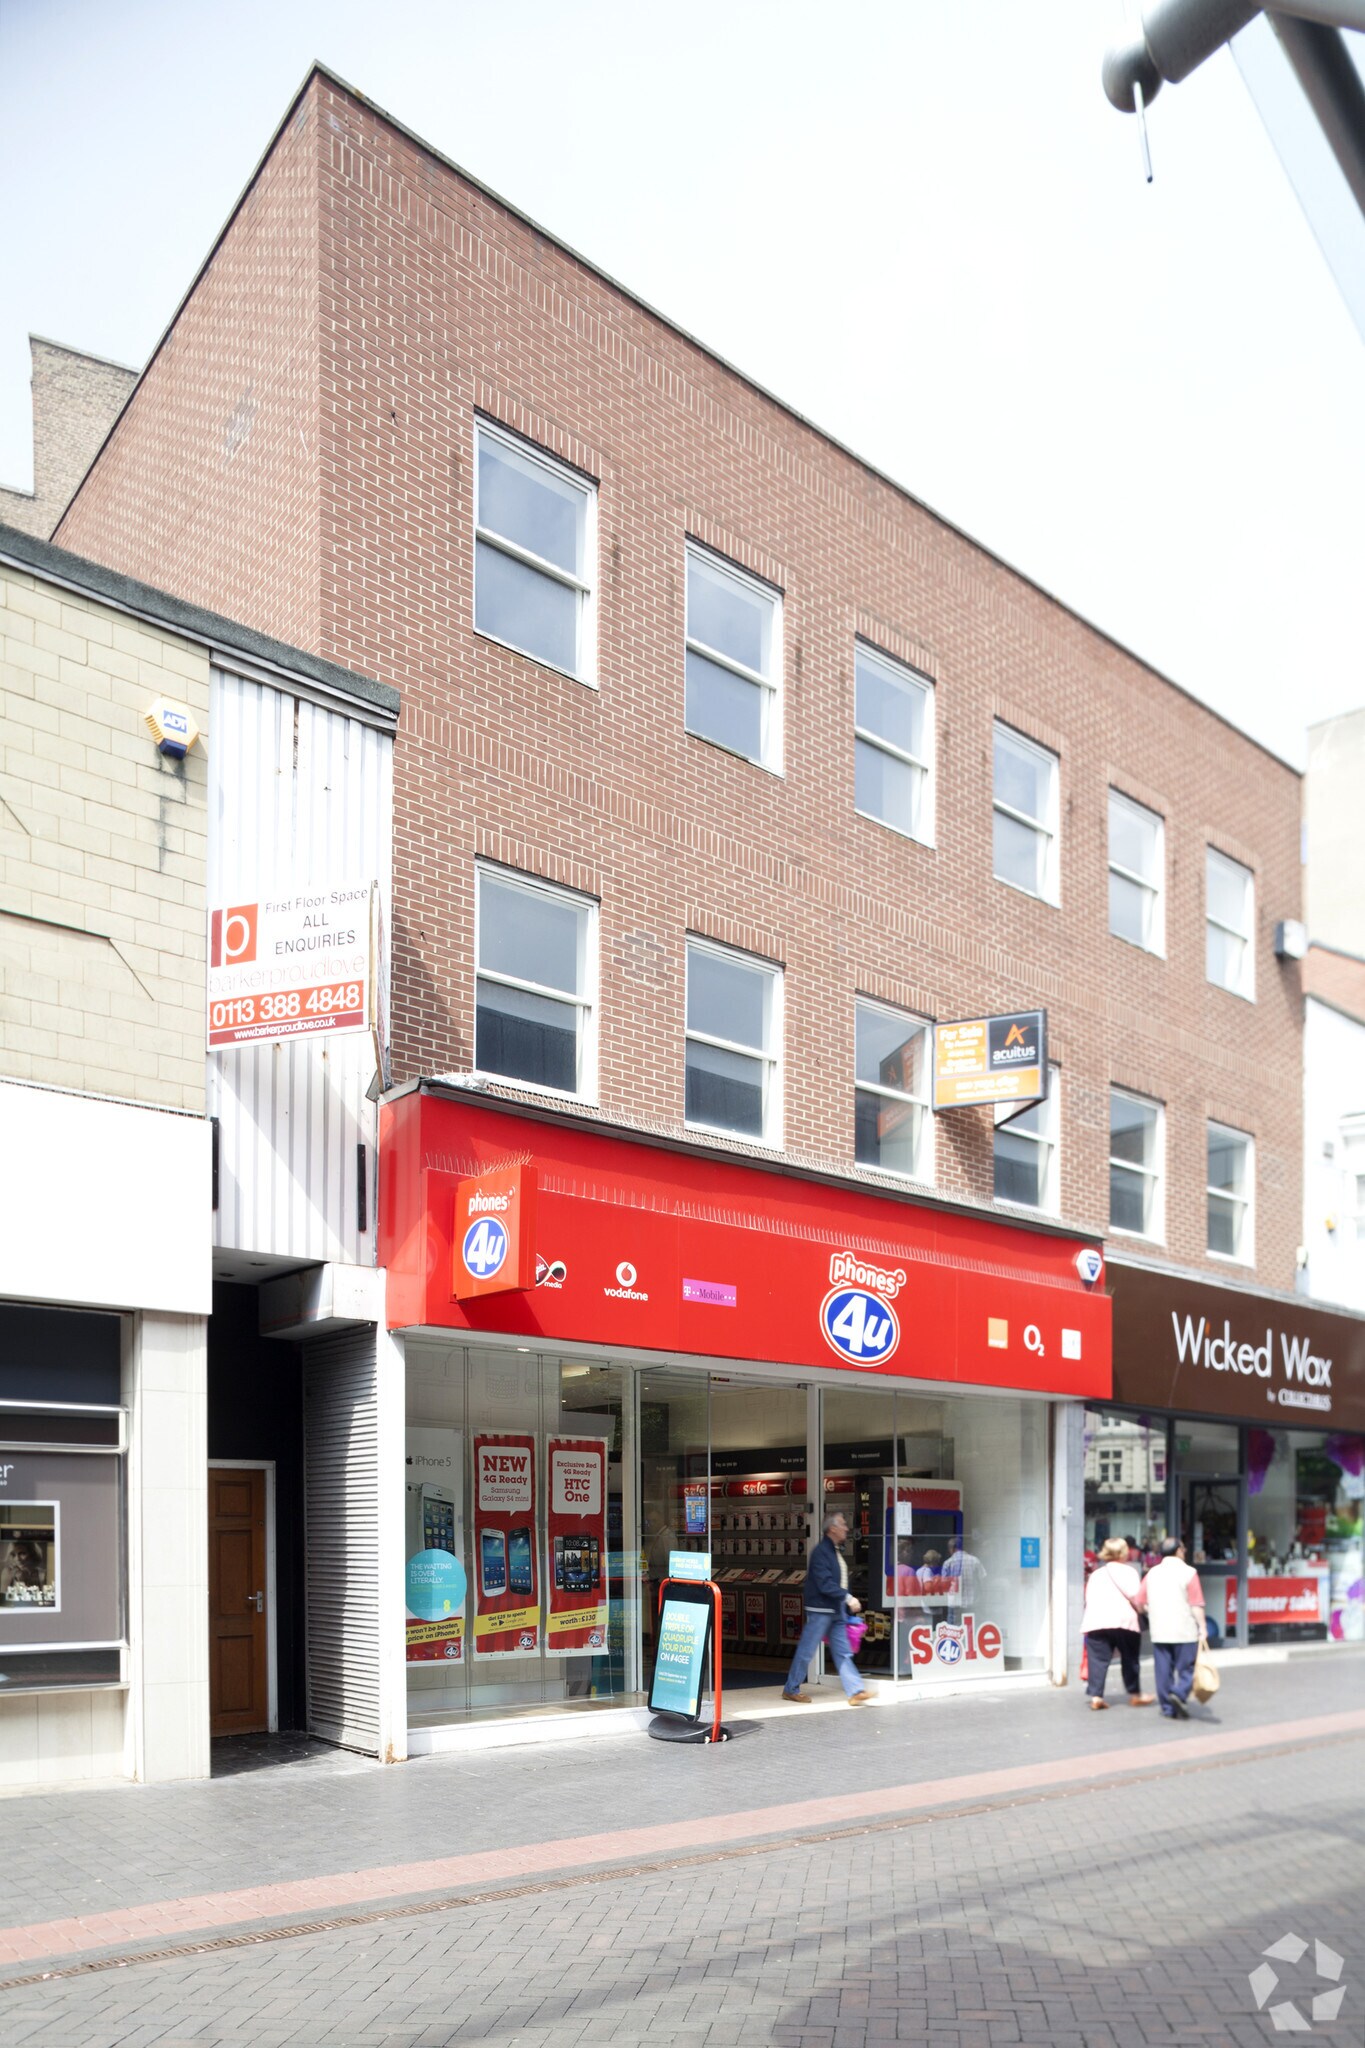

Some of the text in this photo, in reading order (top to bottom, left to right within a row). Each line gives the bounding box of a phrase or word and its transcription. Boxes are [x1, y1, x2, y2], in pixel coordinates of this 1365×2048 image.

[266, 889, 368, 914] First Floor Space
[303, 913, 329, 930] ALL
[275, 930, 356, 955] ENQUIRIES
[209, 955, 365, 994] barkerproudlove
[213, 984, 360, 1028] 0113 388 4848
[234, 1017, 336, 1041] www.barkerproudlove.co.uk
[993, 1045, 1036, 1061] acuitus
[468, 1192, 508, 1217] phones
[466, 1222, 504, 1273] 4u
[833, 1257, 896, 1295] phones
[544, 1281, 563, 1289] media
[604, 1287, 649, 1301] vodafone
[832, 1295, 891, 1354] 4u
[1172, 1311, 1332, 1387] Wicked Wax
[415, 1456, 451, 1467] iPhone 5
[483, 1455, 527, 1472] NEW
[556, 1461, 584, 1469] Exclusive
[572, 1469, 591, 1477] Ready
[483, 1475, 528, 1485] 4G Ready
[564, 1478, 590, 1490] HTC
[490, 1487, 520, 1495] Samsung
[565, 1491, 590, 1502] One
[482, 1495, 506, 1503] Galaxy
[515, 1494, 529, 1502] mini
[1228, 1592, 1288, 1613] smmer
[410, 1627, 427, 1635] won't
[437, 1623, 458, 1631] beaten
[665, 1622, 695, 1633] TRIPLE OR
[407, 1635, 423, 1643] price
[435, 1630, 455, 1638] iPhone
[663, 1632, 700, 1645] QUADRUPLE
[662, 1643, 678, 1652] YOUR
[660, 1652, 670, 1661] ON
